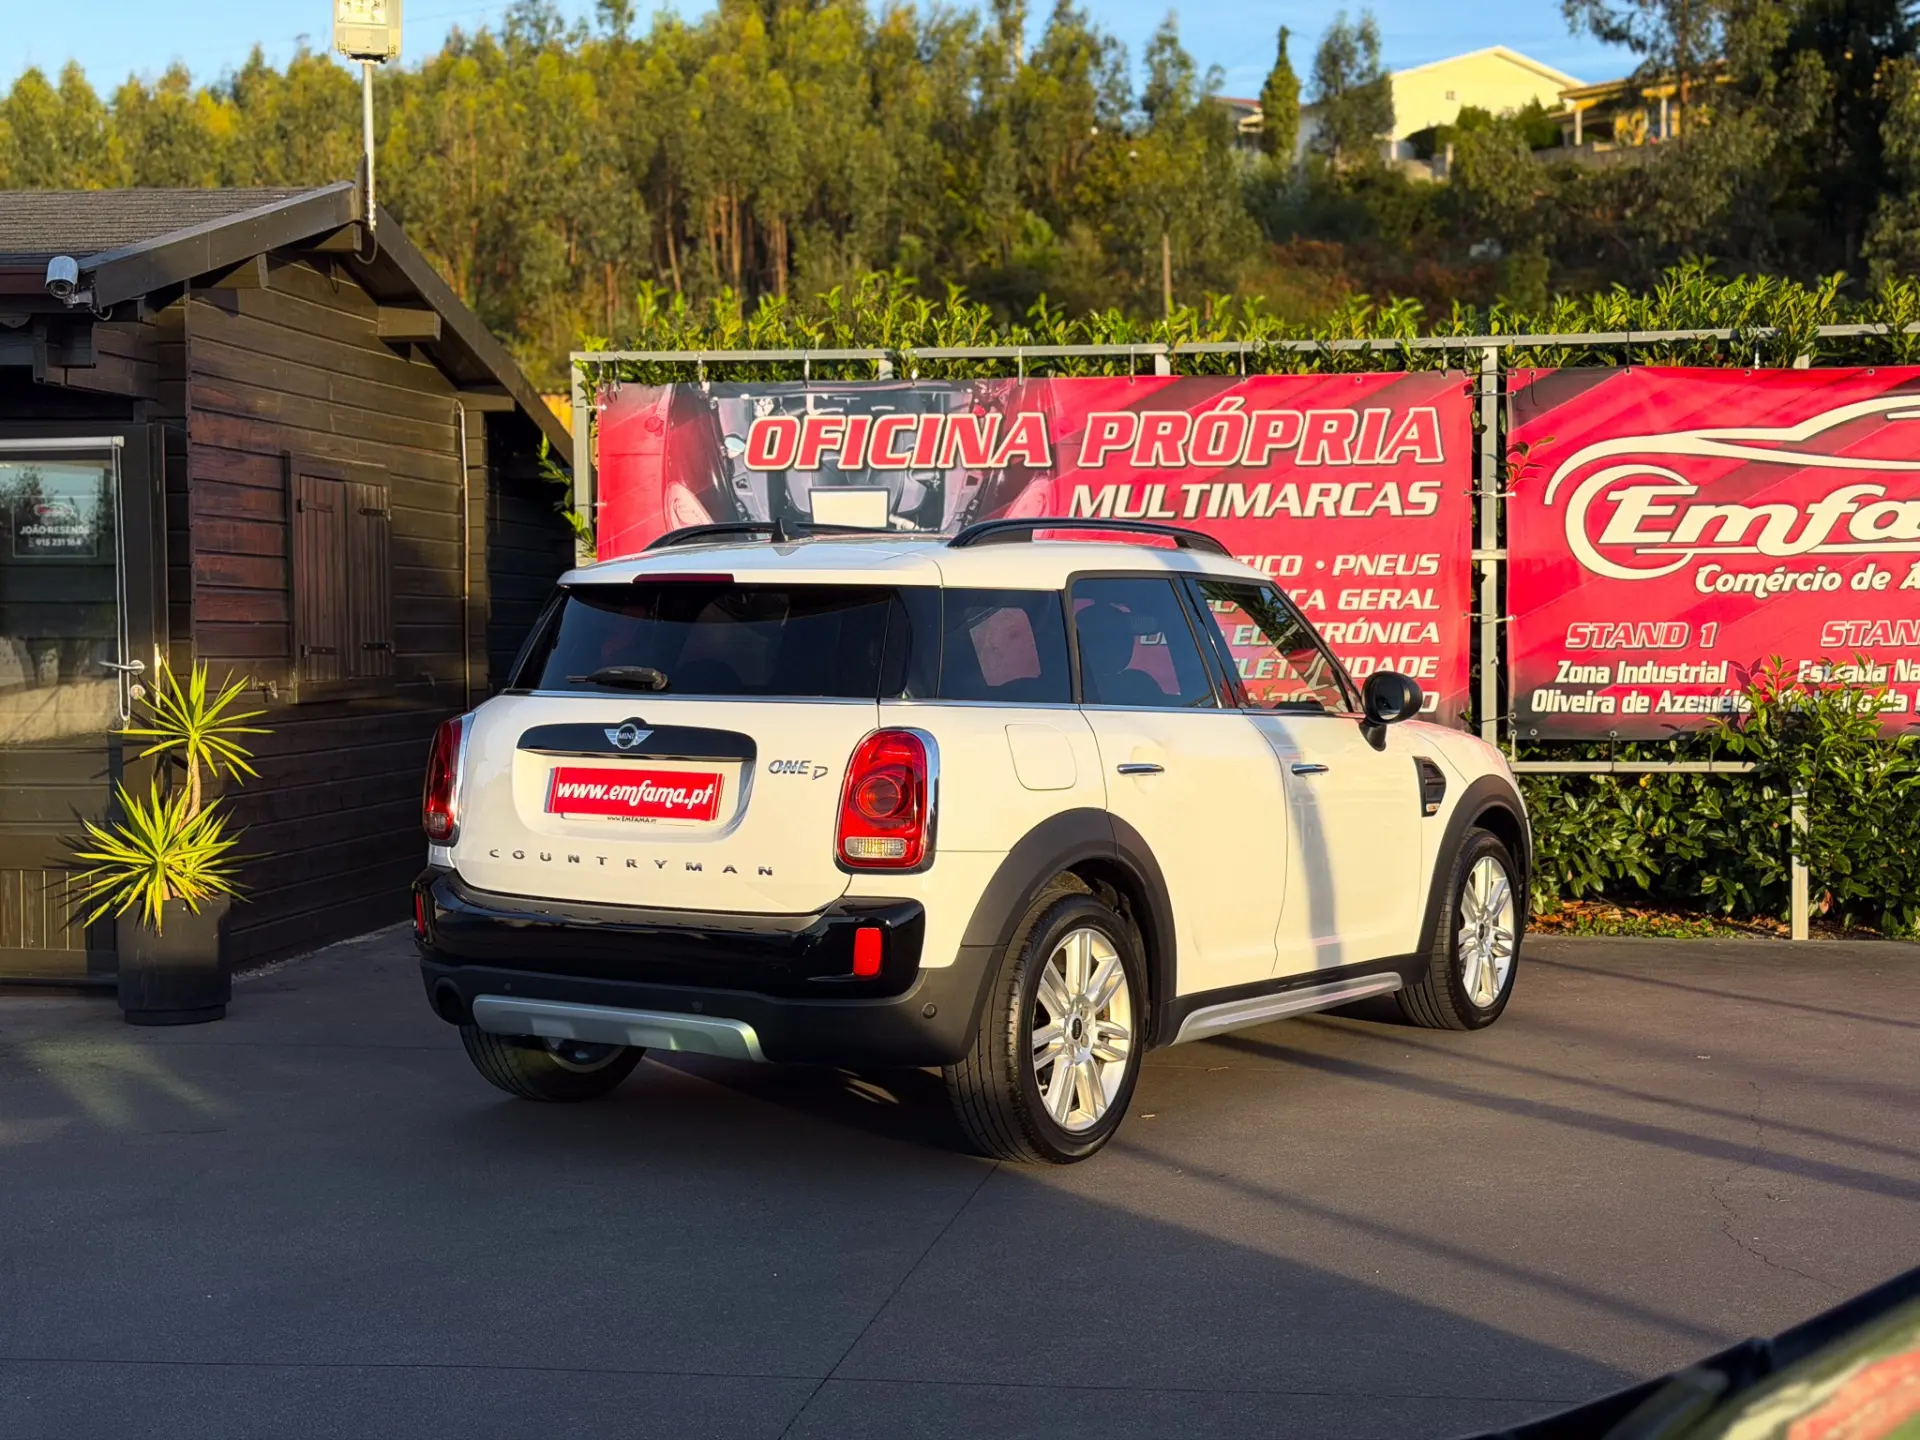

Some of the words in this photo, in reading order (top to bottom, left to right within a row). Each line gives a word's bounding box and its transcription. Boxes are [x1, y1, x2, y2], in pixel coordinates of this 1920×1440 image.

[744, 412, 1052, 470] OFICINA
[1077, 397, 1445, 467] PRÓPRIA
[1069, 481, 1441, 518] MULTIMARCAS
[1332, 552, 1440, 577] PNEUS
[1695, 563, 1842, 598] Comércio
[1850, 563, 1892, 591] de
[1337, 588, 1441, 611] GERAL
[1565, 622, 1690, 649] STAND
[1700, 622, 1719, 648] 1
[1554, 660, 1611, 685] Zona
[1616, 660, 1728, 685] Industrial
[1531, 689, 1616, 714] Oliveira
[1621, 690, 1650, 714] de
[1655, 689, 1753, 714] Azeméis
[618, 731, 635, 740] MINI
[768, 759, 812, 775] ONE
[812, 765, 829, 781] D
[557, 780, 715, 810] www.emfama.pt
[489, 849, 774, 877] COUNTRYMAN
